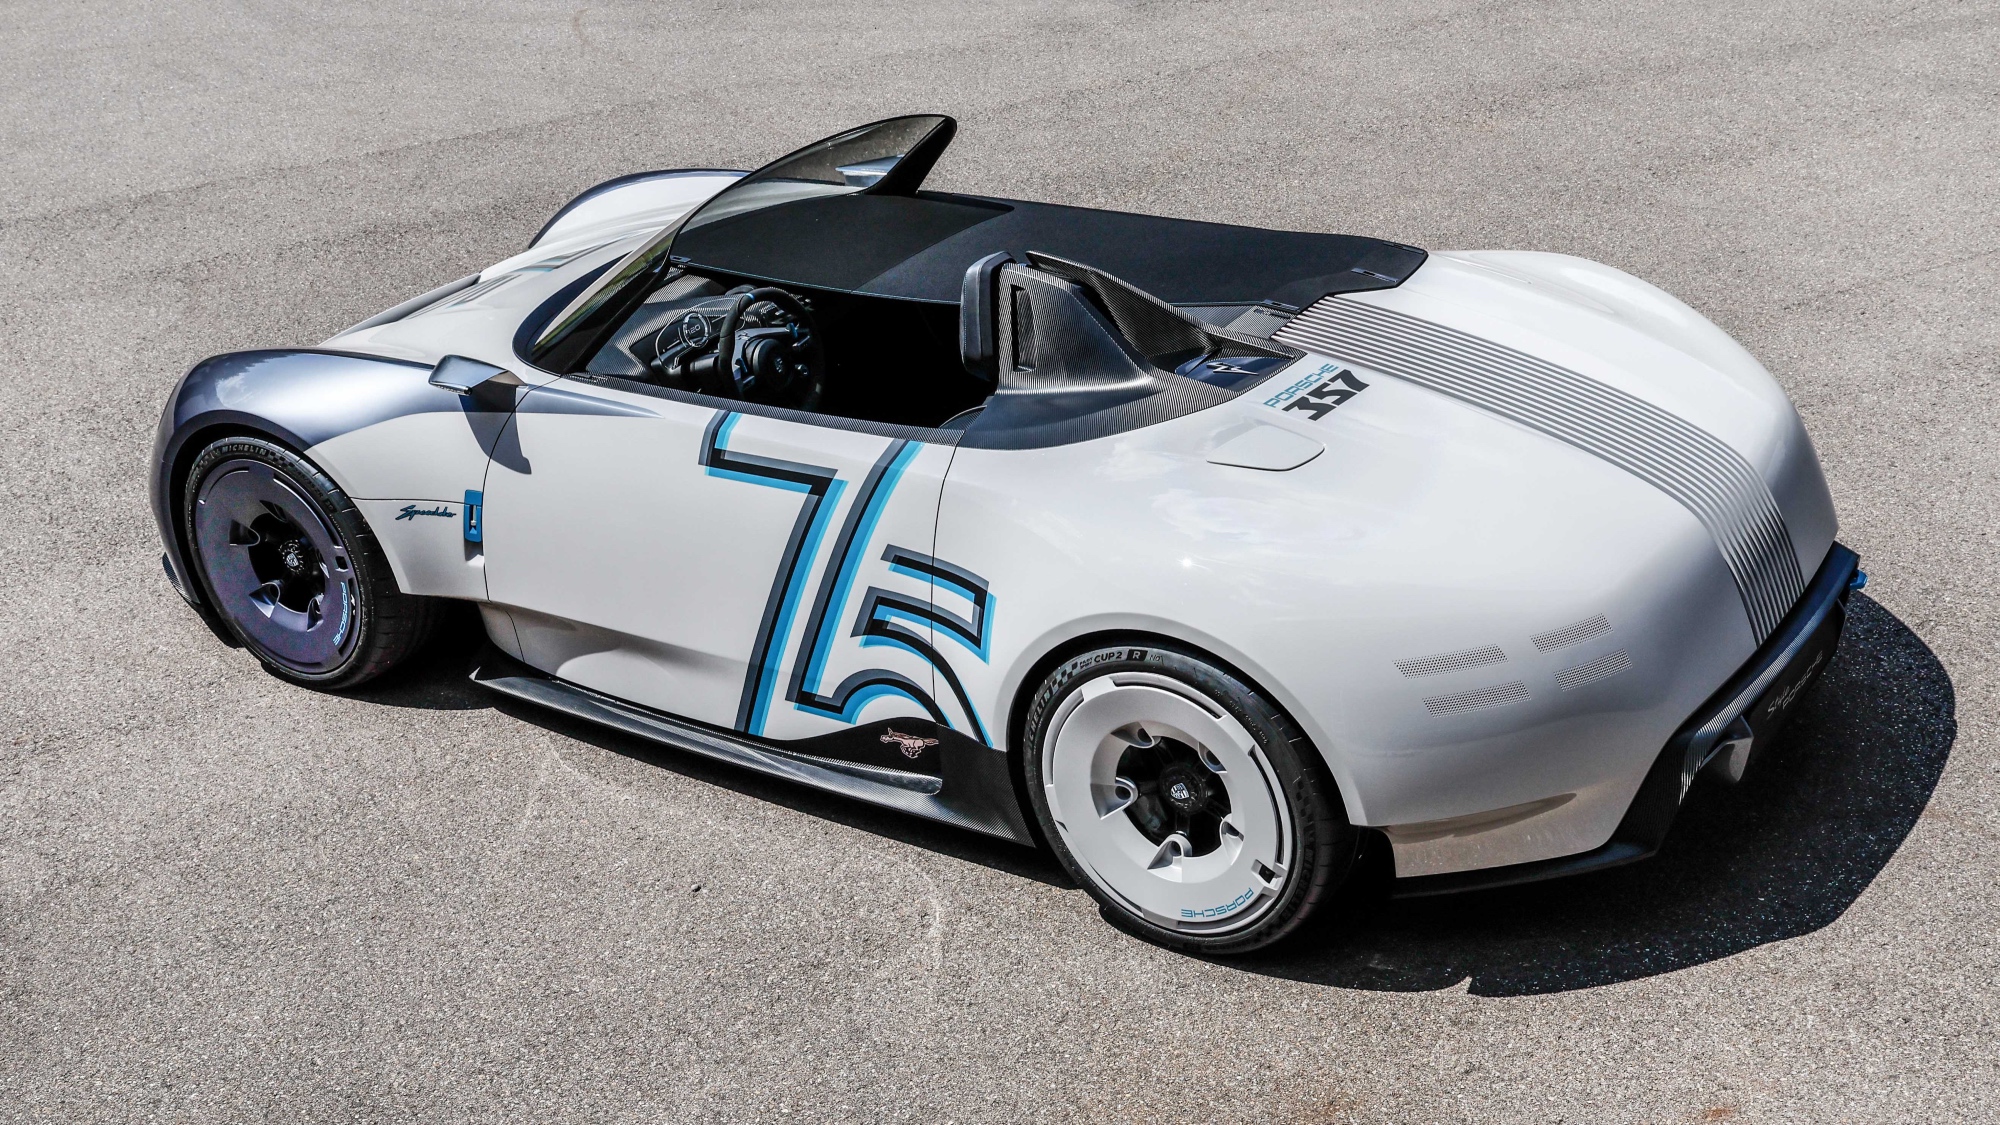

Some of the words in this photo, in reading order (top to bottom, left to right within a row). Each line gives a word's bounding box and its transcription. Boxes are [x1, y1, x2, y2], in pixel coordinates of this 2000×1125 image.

[1263, 363, 1340, 408] PORSCHE
[1281, 369, 1370, 421] 357
[221, 444, 267, 456] MICHELIN
[698, 410, 998, 748] 75
[333, 581, 348, 646] PORSCHE
[1094, 652, 1115, 663] CUP
[1116, 651, 1123, 660] 2
[1133, 651, 1141, 660] R
[1181, 888, 1255, 918] PORSCHE
